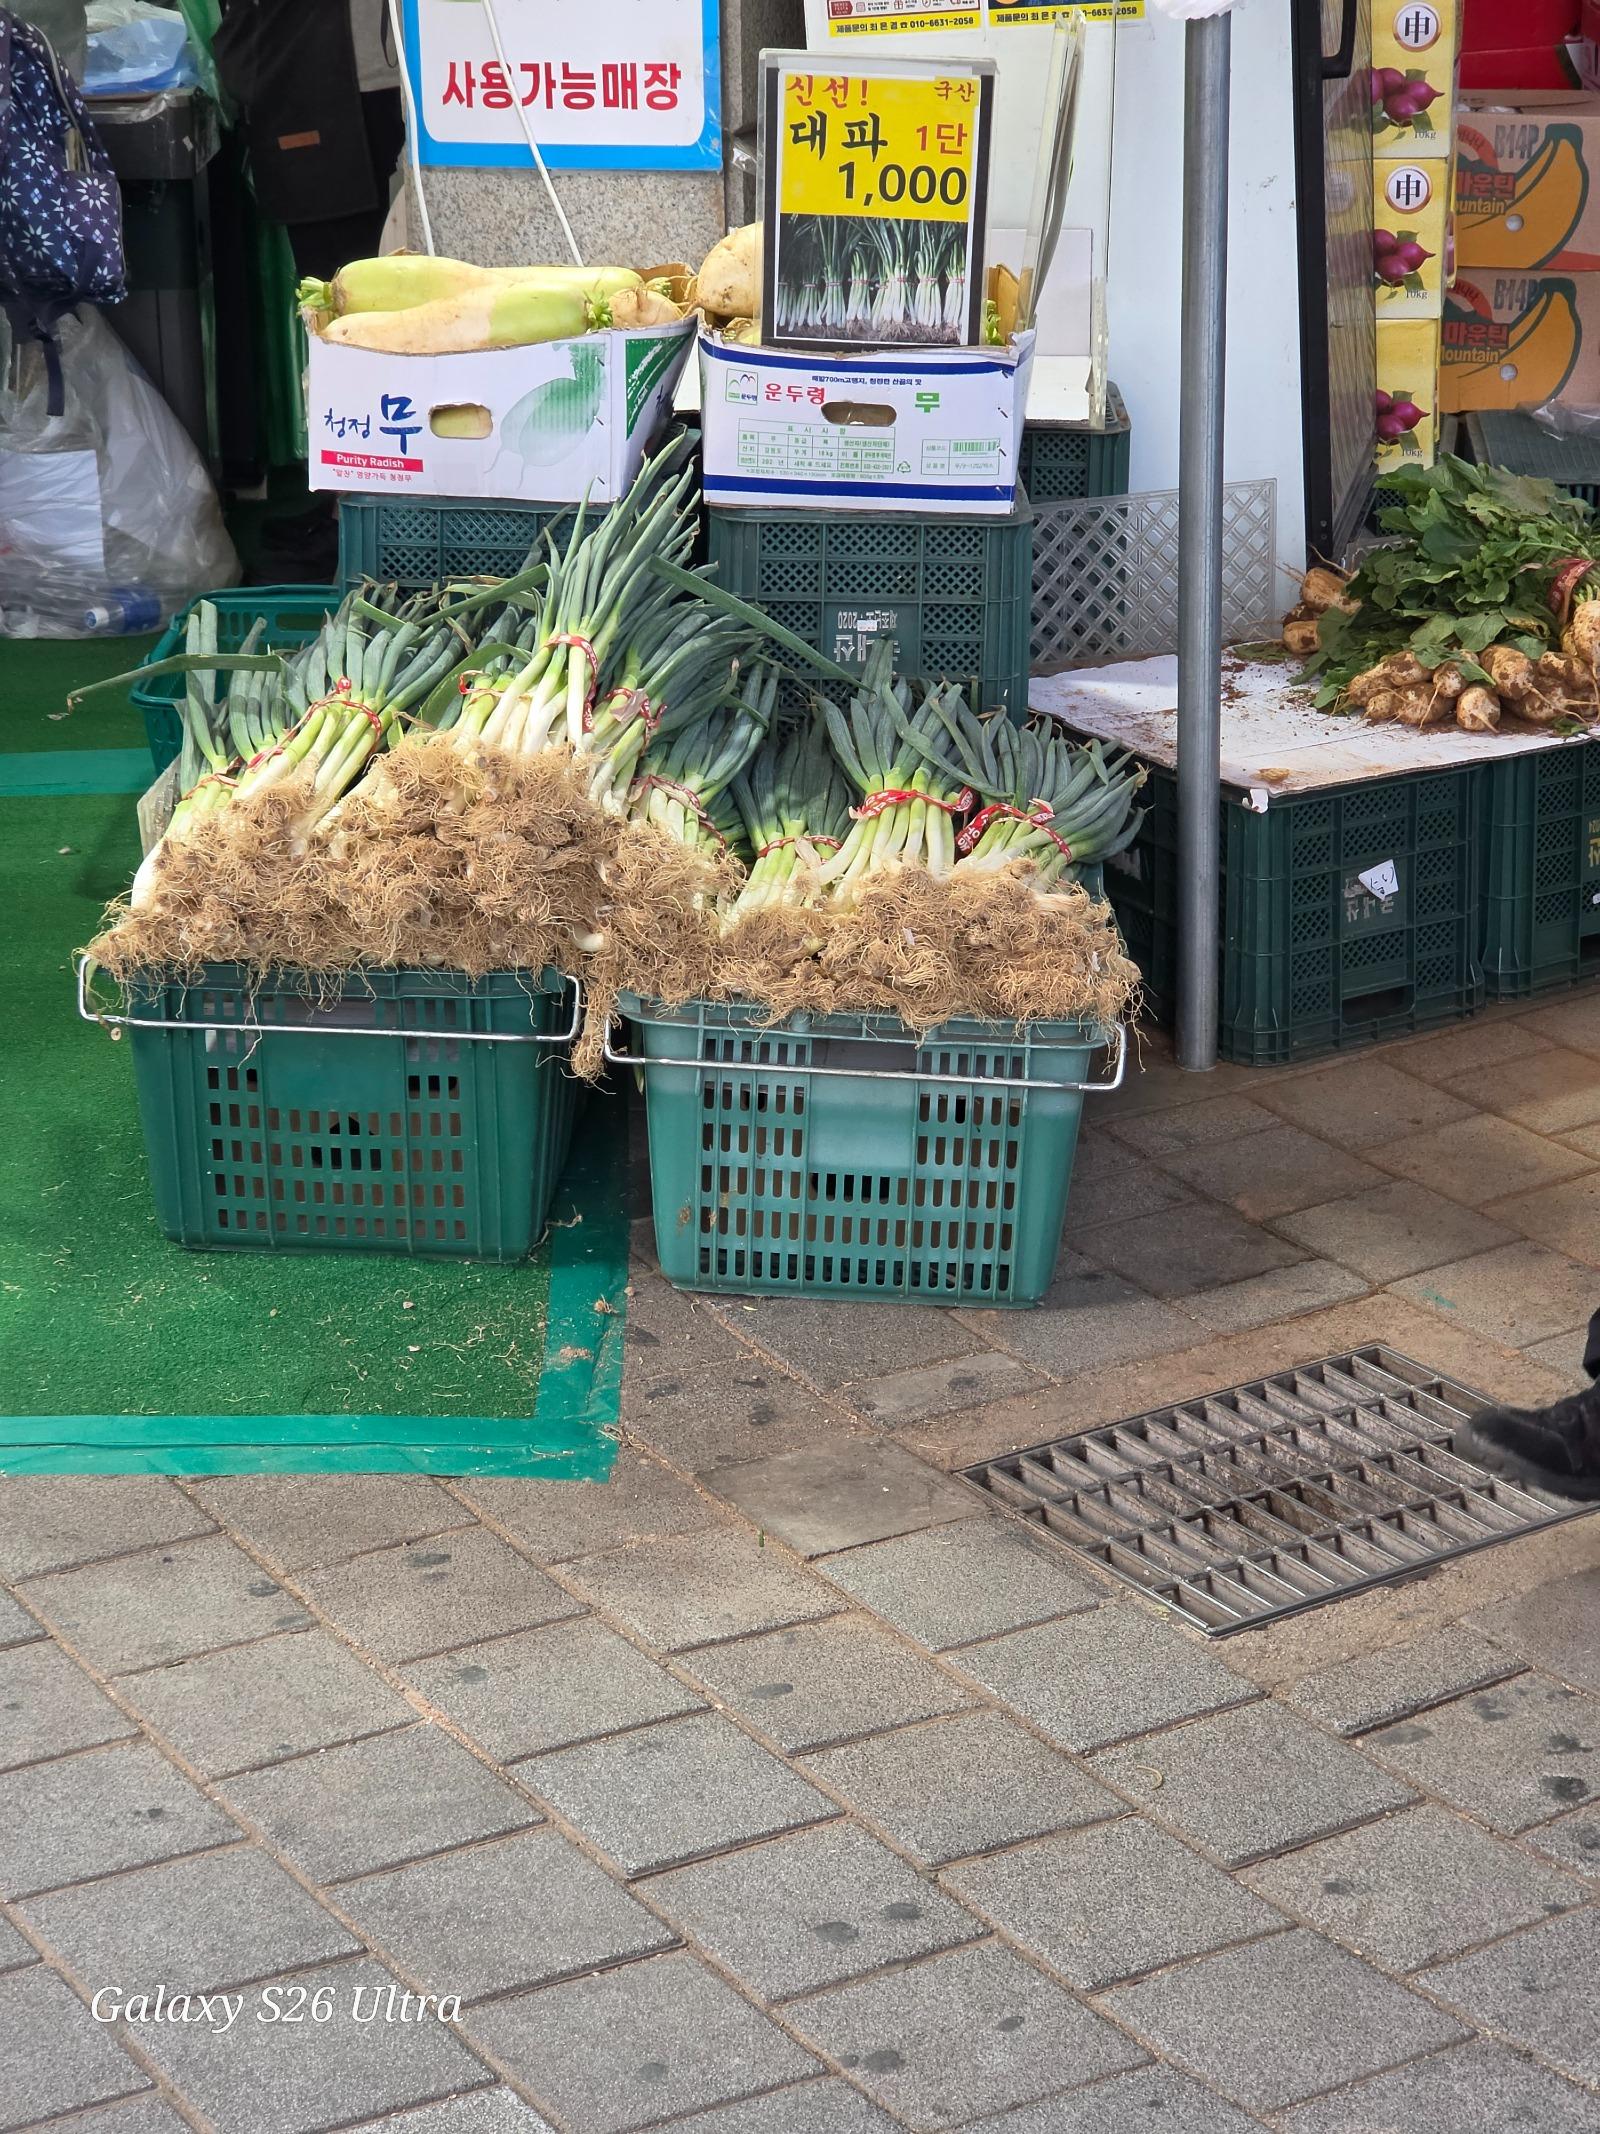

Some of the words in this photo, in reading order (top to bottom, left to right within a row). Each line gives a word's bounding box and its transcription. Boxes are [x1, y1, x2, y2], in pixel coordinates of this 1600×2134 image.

[910, 16, 974, 28] 010-6631-2058
[442, 60, 682, 111] 사용가능매장
[934, 80, 975, 103] 국산
[915, 122, 968, 156] 1단
[1414, 130, 1437, 140] 10kg
[838, 160, 968, 207] 1,000
[1406, 289, 1428, 300] 10kg
[1443, 321, 1509, 349] 마운틴
[1440, 346, 1499, 363] ountain
[764, 382, 826, 405] 운두령
[915, 392, 940, 413] 무
[323, 407, 371, 439] 청정
[379, 393, 423, 456] 무
[336, 453, 368, 466] Purity
[370, 457, 405, 469] Radish
